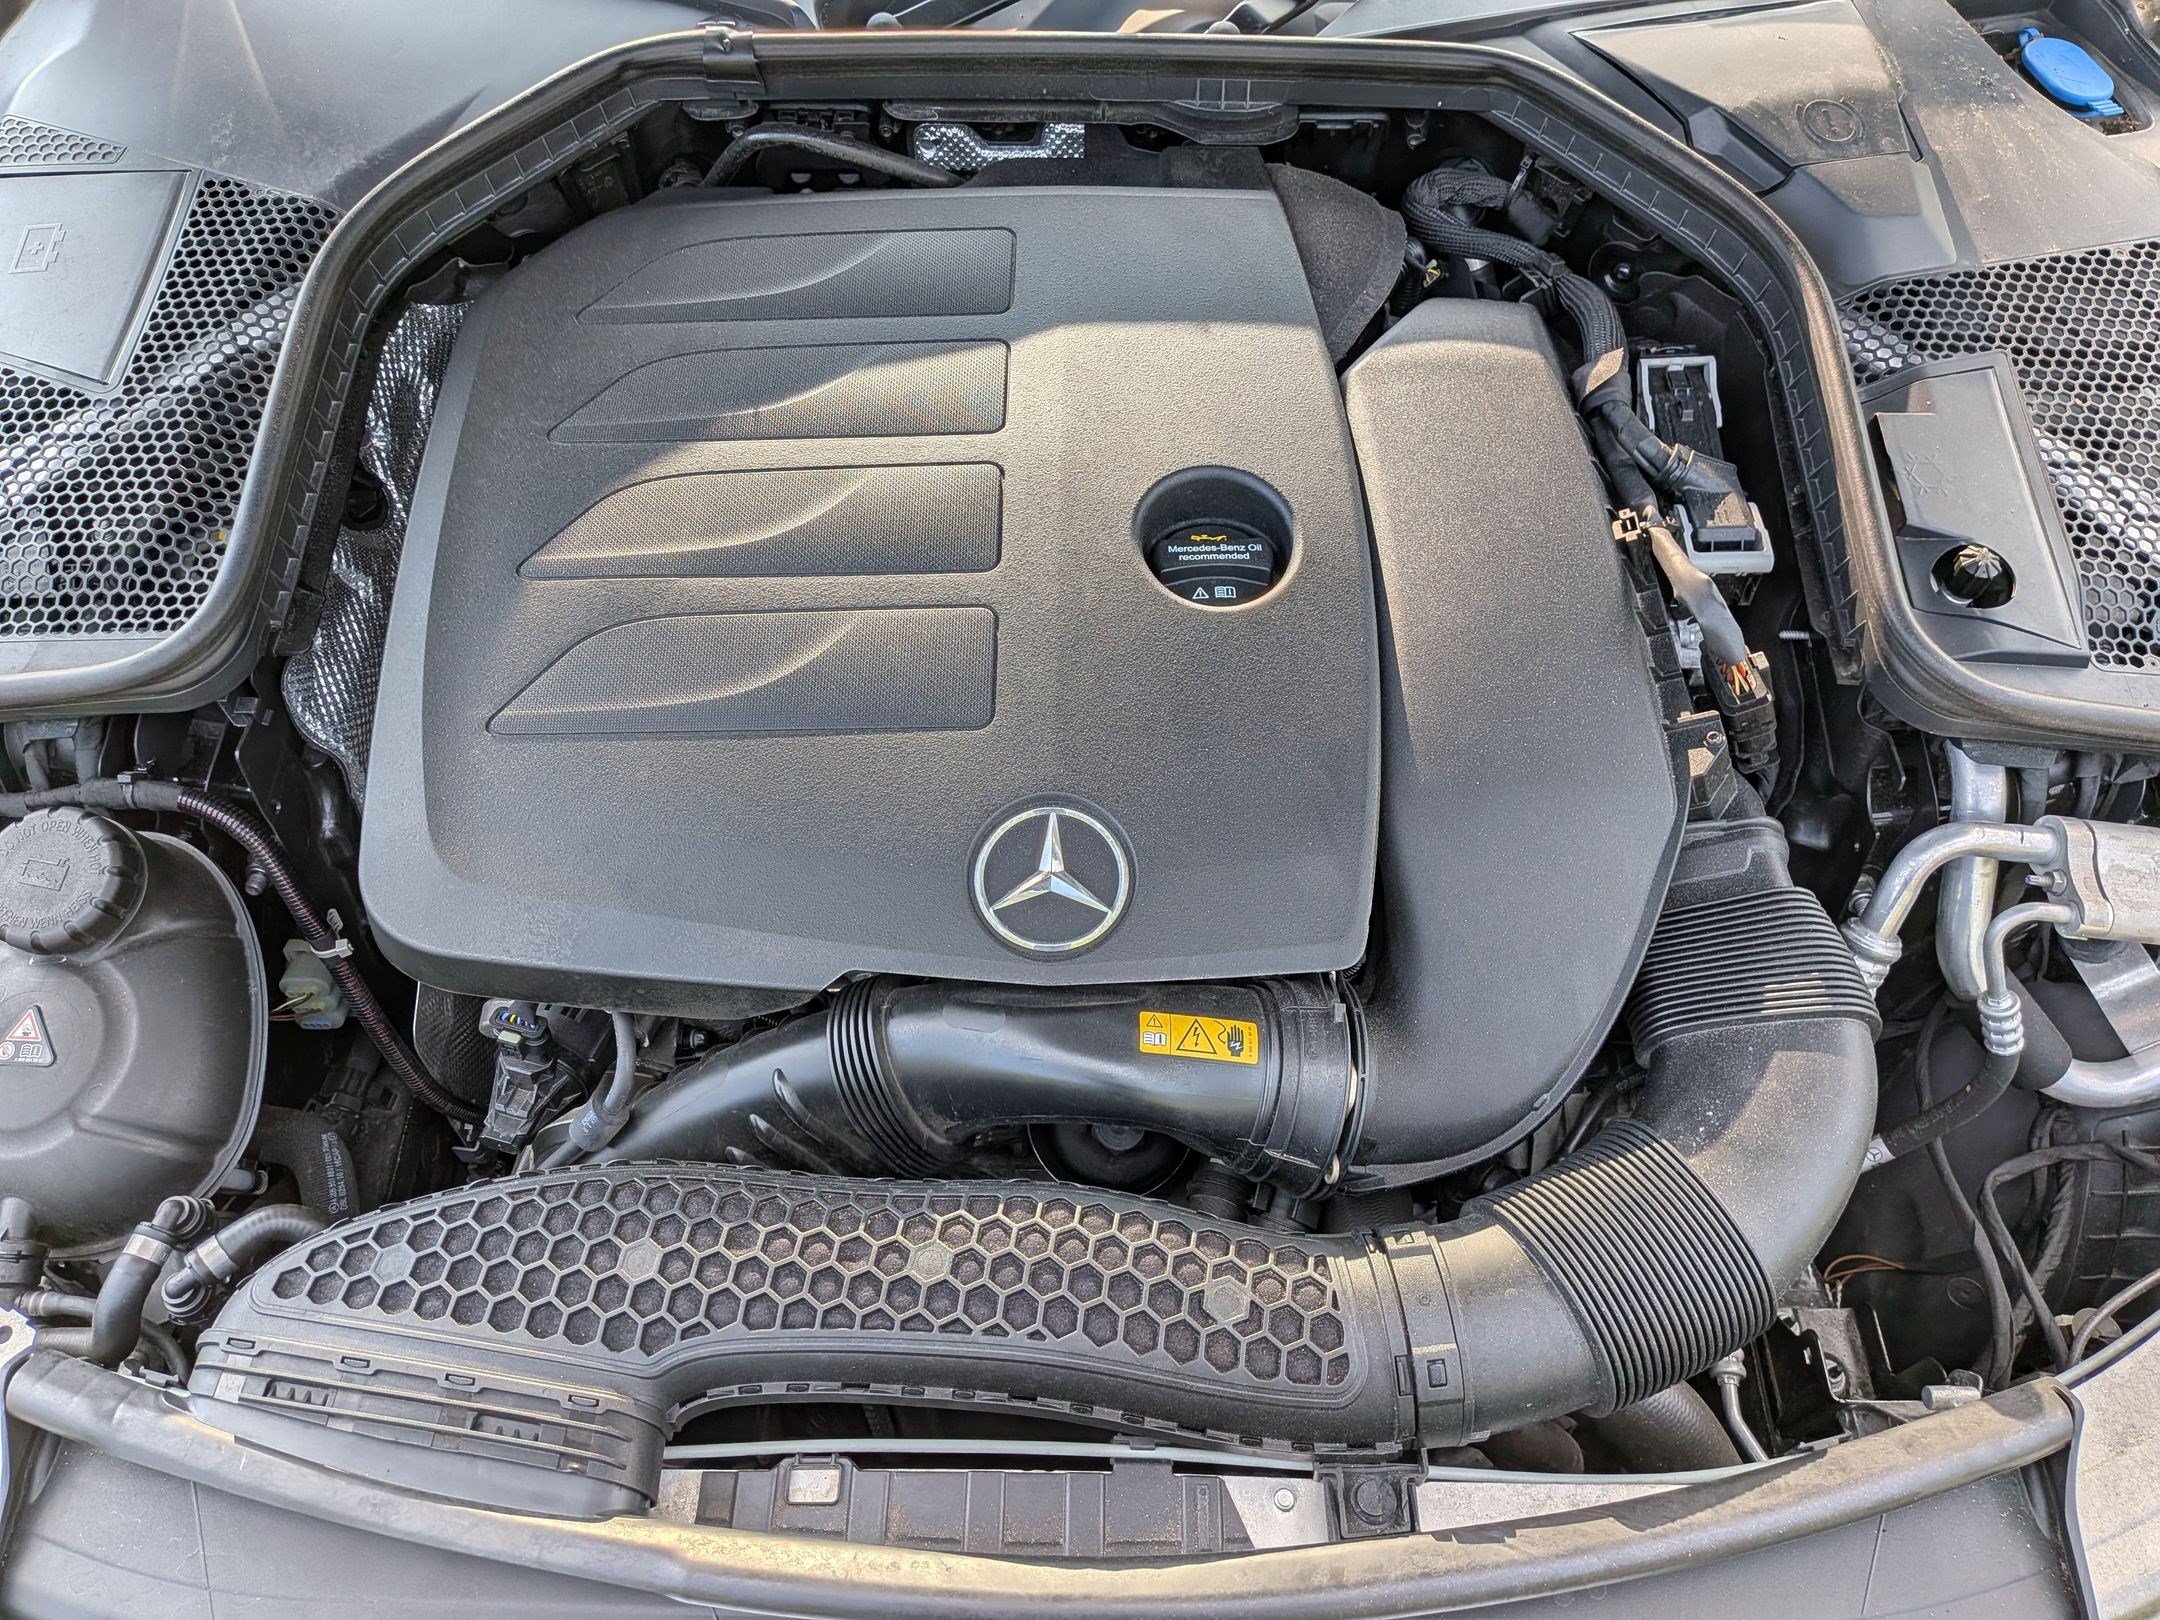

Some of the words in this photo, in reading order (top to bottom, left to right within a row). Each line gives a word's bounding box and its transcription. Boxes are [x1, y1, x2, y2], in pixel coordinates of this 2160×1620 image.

[1167, 543, 1246, 553] Mercedes-Benz
[1248, 543, 1263, 552] Oil
[1179, 552, 1251, 561] recommended
[15, 823, 37, 843] NOT
[41, 820, 72, 833] OPEN
[71, 824, 98, 853] WHEN
[30, 913, 63, 929] WENN
